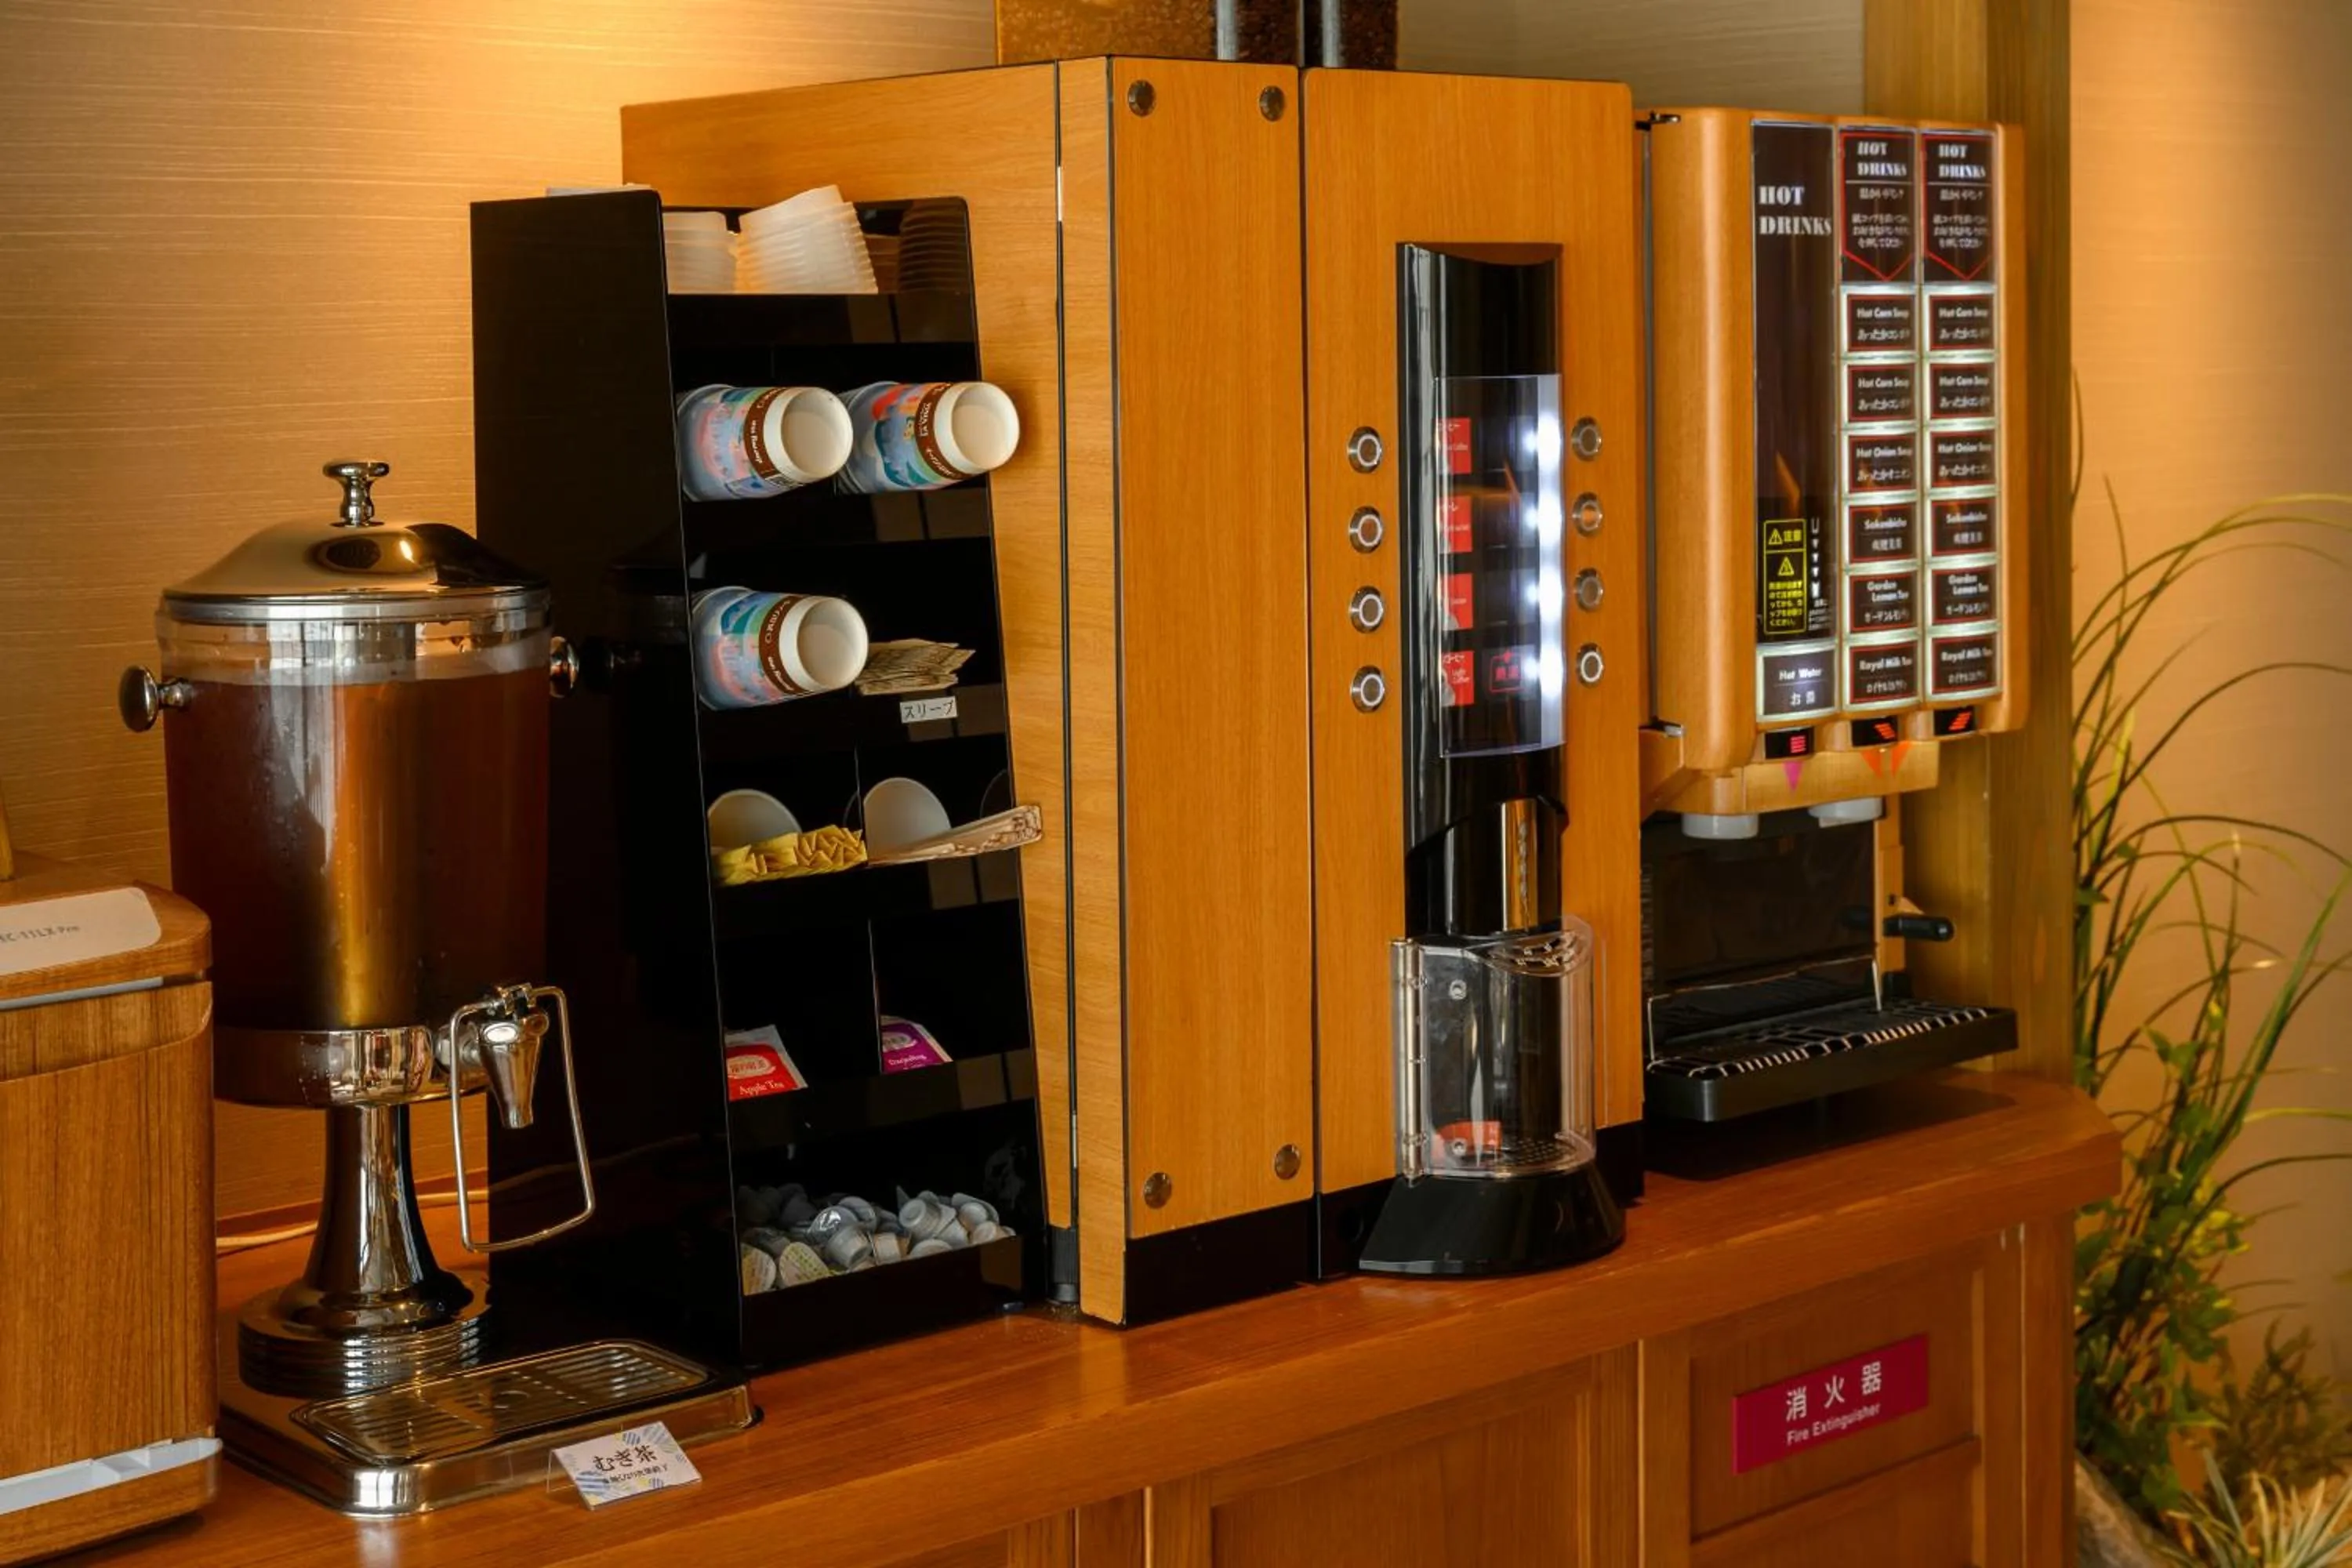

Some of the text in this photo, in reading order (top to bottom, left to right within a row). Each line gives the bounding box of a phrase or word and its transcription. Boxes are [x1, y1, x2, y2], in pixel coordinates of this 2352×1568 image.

[1857, 141, 1889, 156] HOT
[1938, 143, 1968, 158] HOT
[1857, 162, 1907, 177] DRINKS
[1938, 164, 1987, 179] DRINKS
[1759, 186, 1805, 205] HOT
[1759, 216, 1831, 235] DRINKS
[1857, 307, 1872, 318] Hot
[1939, 307, 1955, 318] Hot
[1858, 378, 1874, 388] Hot
[1939, 376, 1955, 387] Hot
[1857, 447, 1872, 459] Hot
[1937, 443, 1953, 453] Hot
[1860, 659, 1883, 673] Royal
[1885, 656, 1900, 668] Milk
[1779, 668, 1822, 681] Hot Water
[1786, 1361, 1882, 1422] 消火器
[1786, 1403, 1881, 1446] Fire Extinguisher
[593, 1444, 659, 1472] むぎ茶
